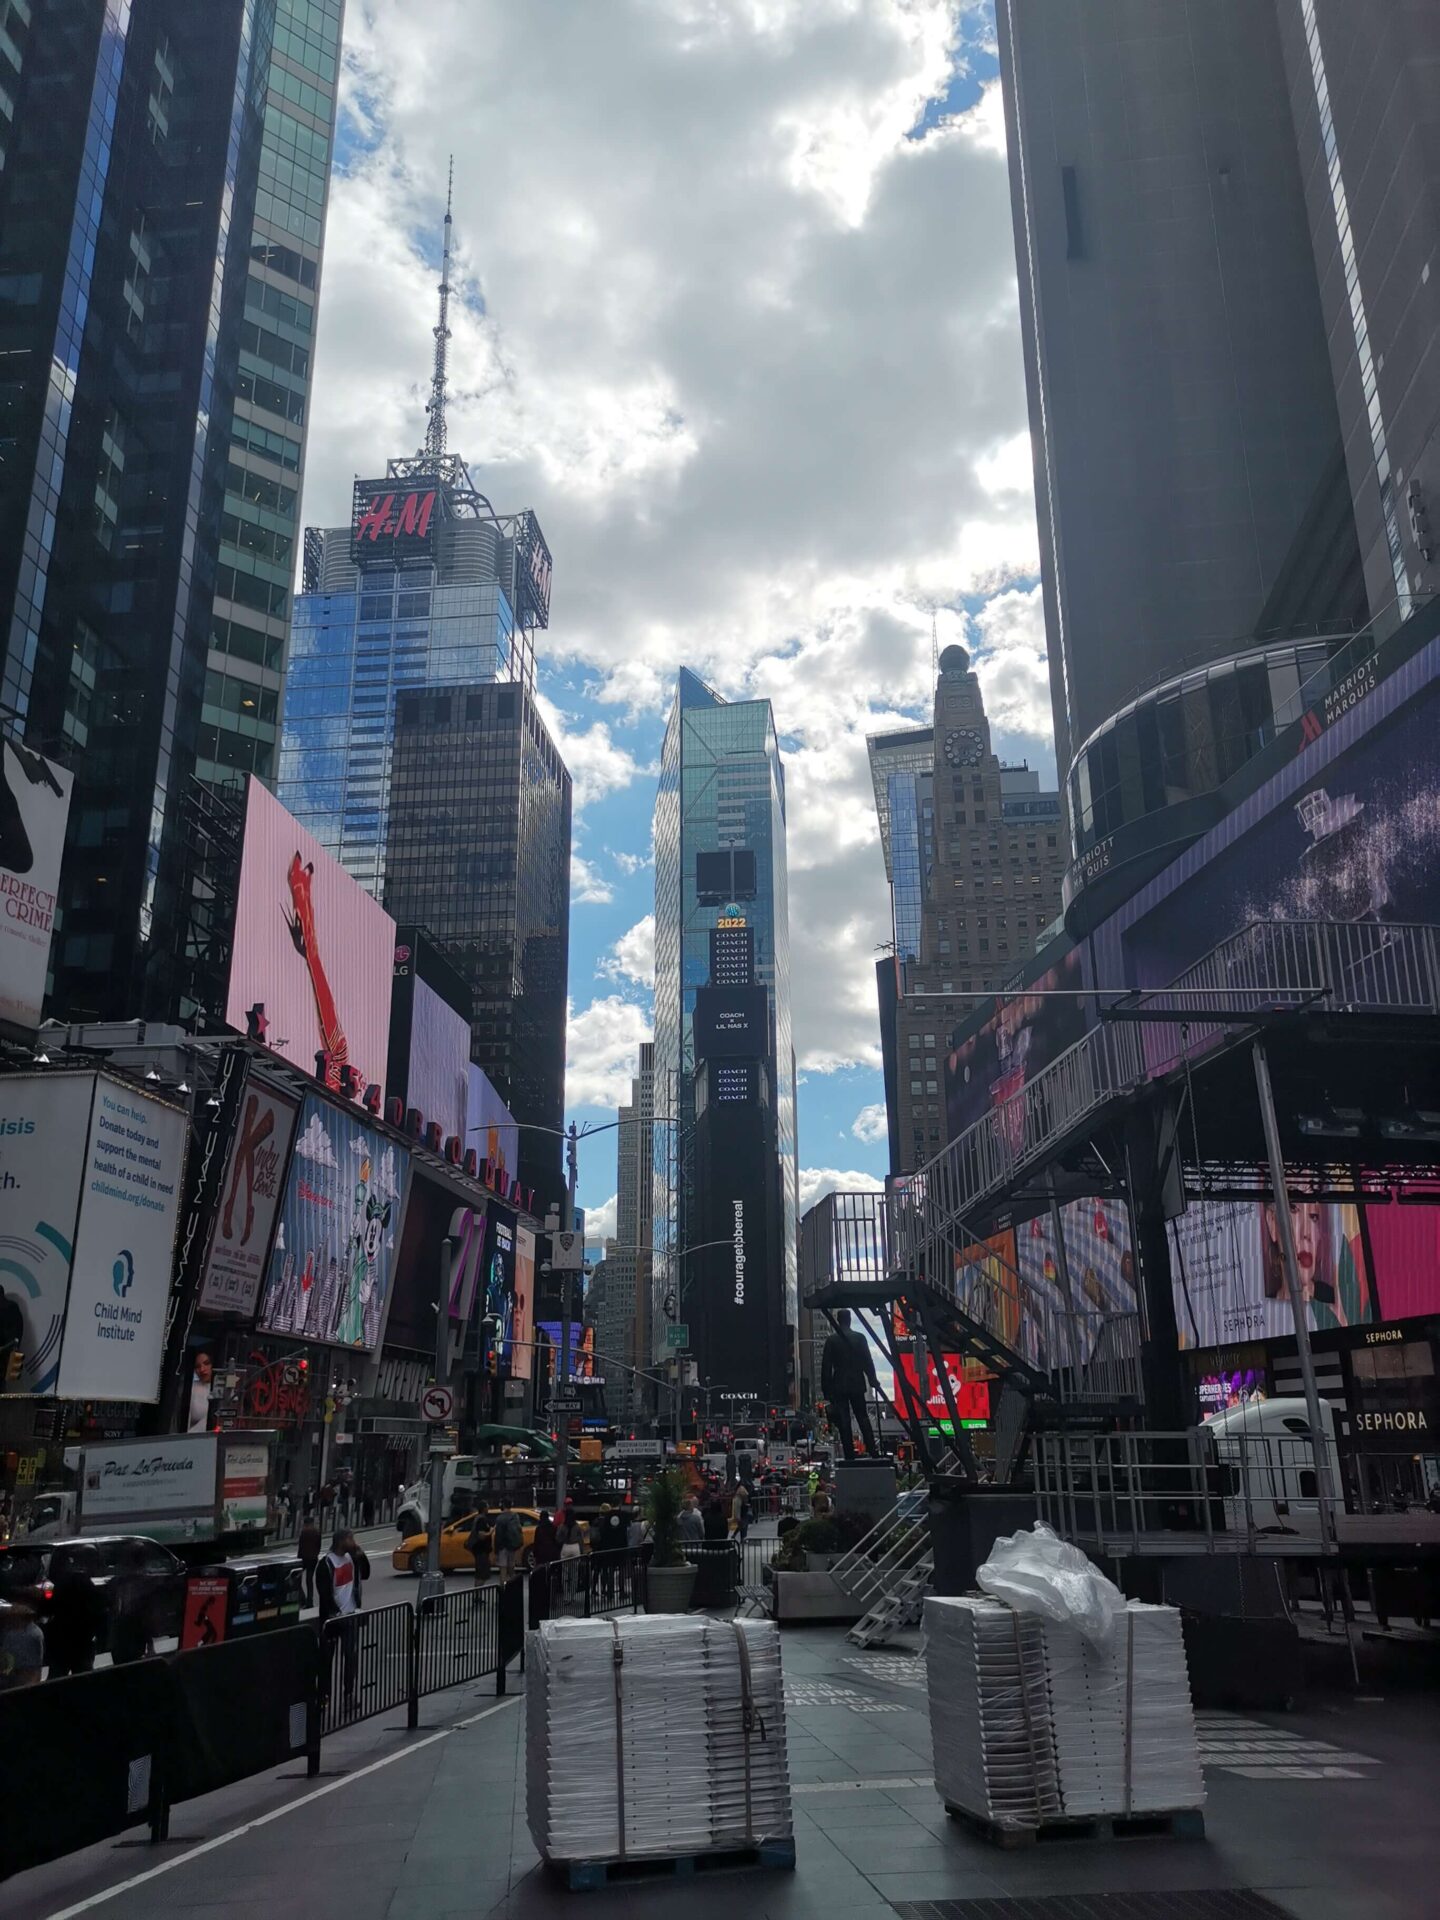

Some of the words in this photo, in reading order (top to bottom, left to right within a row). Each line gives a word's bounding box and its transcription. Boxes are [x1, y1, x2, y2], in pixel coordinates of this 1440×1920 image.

[1324, 652, 1380, 708] MARRIOTT
[1326, 675, 1377, 726] MARQUIS
[1072, 836, 1114, 876] MARRIOTT
[1073, 855, 1110, 890] MAQUIS
[0, 873, 56, 913] ERFECT
[6, 897, 53, 933] CRIME
[717, 918, 746, 929] 2022
[393, 965, 409, 976] LG
[103, 1096, 116, 1111] You
[117, 1103, 130, 1117] can
[130, 1107, 148, 1124] help.
[99, 1115, 126, 1136] Donate
[126, 1127, 145, 1146] today
[145, 1137, 160, 1150] and
[97, 1139, 125, 1158] support
[125, 1149, 138, 1162] the
[138, 1154, 162, 1171] mental
[406, 1108, 535, 1219] BROADWAY
[94, 1159, 118, 1176] health
[117, 1167, 127, 1178] of
[131, 1173, 149, 1187] child
[149, 1176, 157, 1190] in
[157, 1181, 174, 1196] need
[91, 1179, 166, 1213] childmind.org/donate
[732, 1200, 746, 1305] #couragetobereal
[94, 1302, 117, 1320] Child
[119, 1306, 142, 1324] Mind
[1224, 1315, 1266, 1333] SEPHORA
[98, 1323, 136, 1342] Institute
[1365, 1329, 1404, 1344] SEPHORA
[565, 1402, 579, 1410] WAY
[720, 1392, 757, 1400] COACH
[103, 1430, 121, 1440] SONY
[1356, 1411, 1428, 1431] SEPHORA
[104, 1461, 126, 1477] Pat
